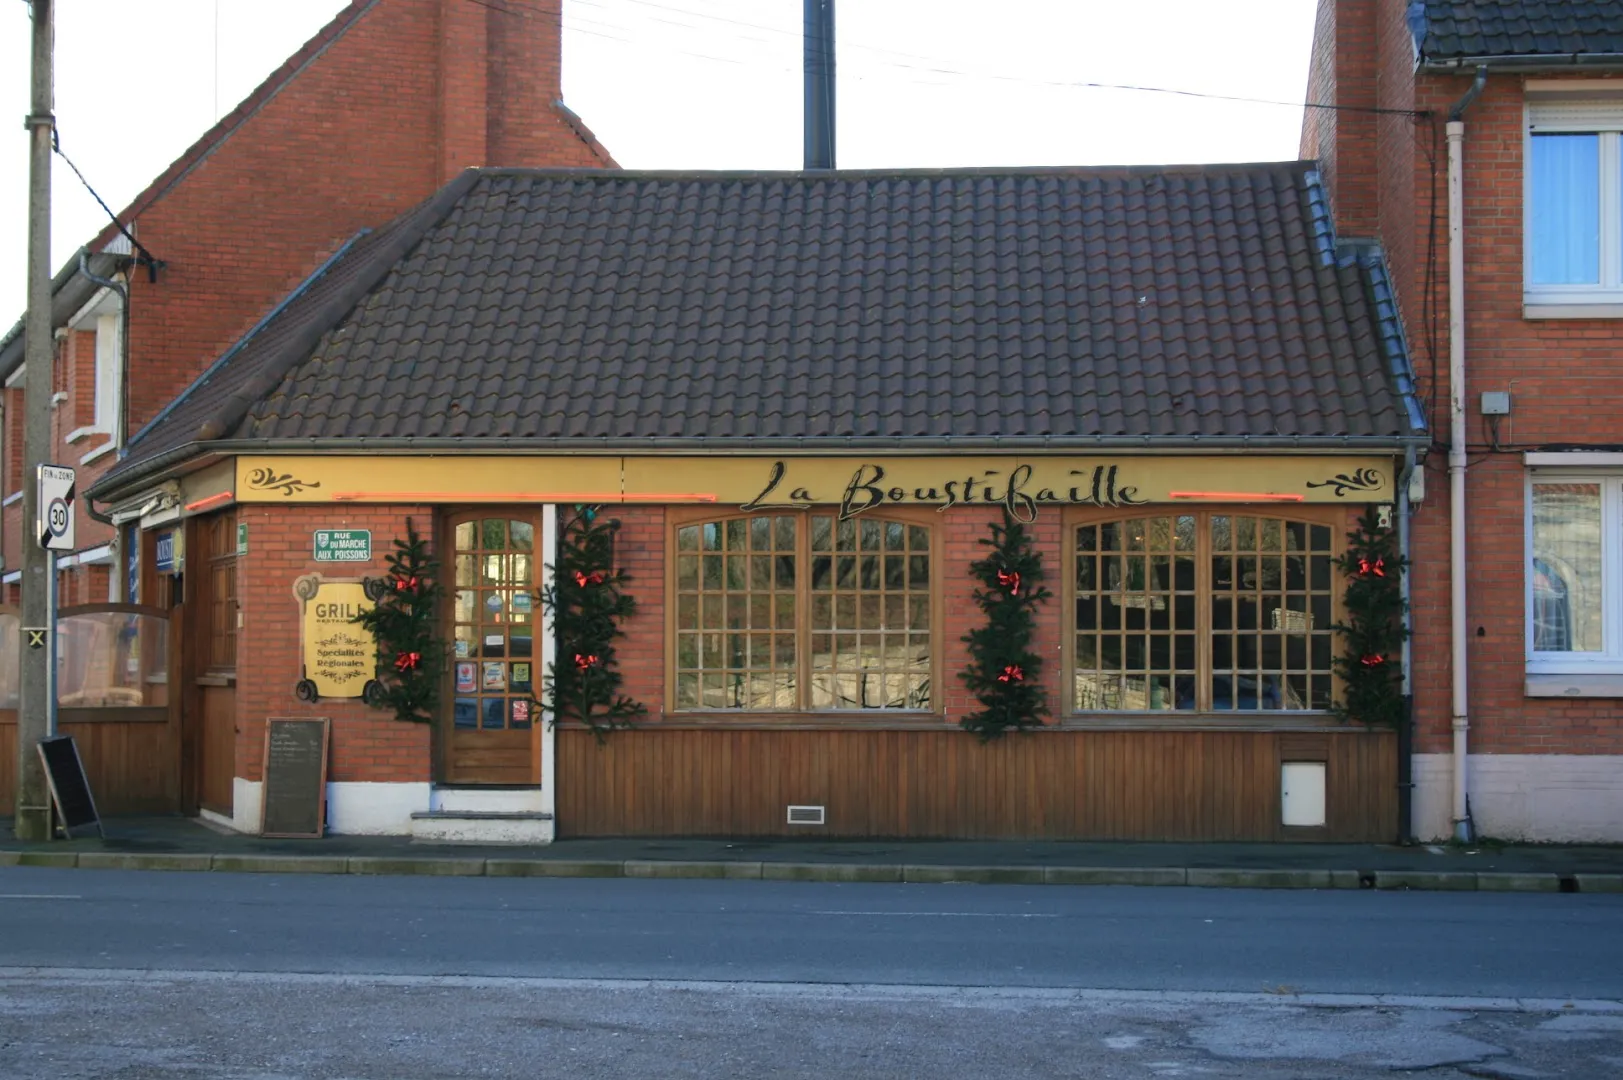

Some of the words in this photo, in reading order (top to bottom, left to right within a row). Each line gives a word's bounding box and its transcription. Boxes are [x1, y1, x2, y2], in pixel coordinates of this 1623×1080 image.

[44, 469, 54, 478] FIN
[59, 471, 73, 481] ZONE
[740, 461, 820, 512] La
[839, 464, 1149, 523] Boustifaille
[52, 508, 64, 526] 30
[339, 540, 366, 548] MARCHE
[318, 550, 332, 559] AUX
[334, 550, 368, 559] POISSONS
